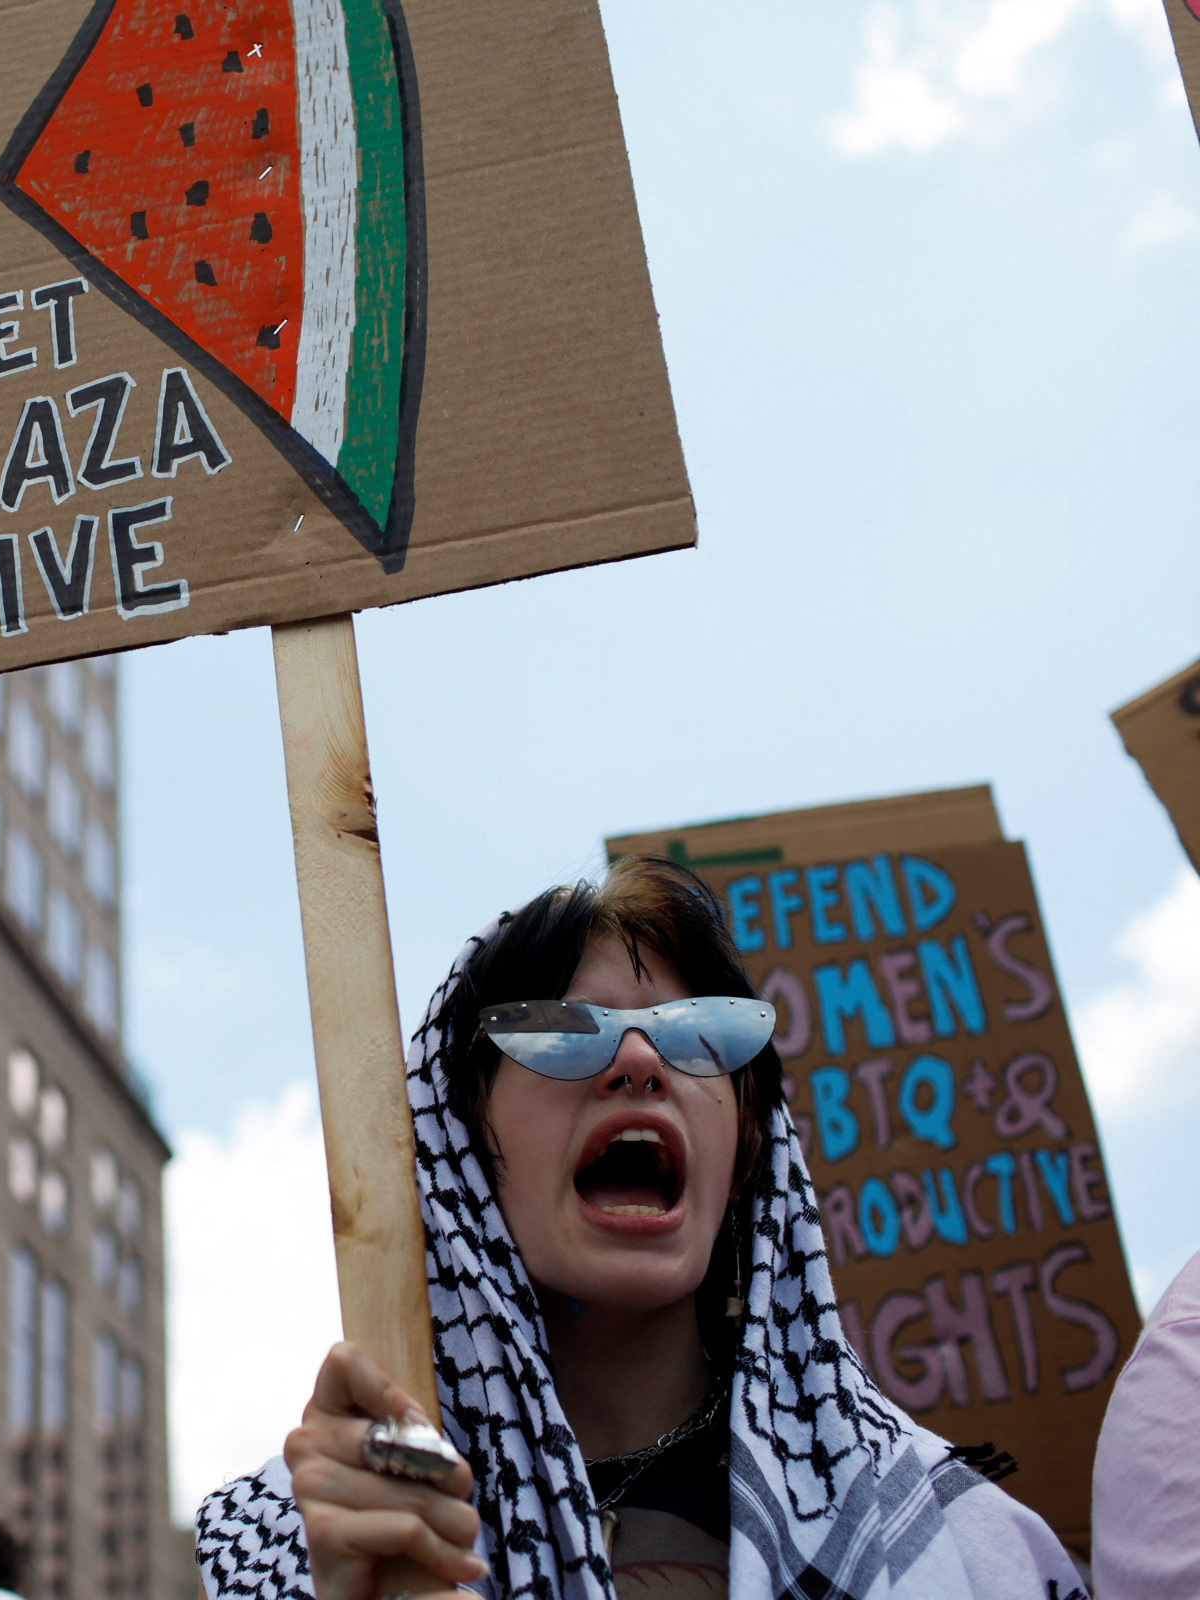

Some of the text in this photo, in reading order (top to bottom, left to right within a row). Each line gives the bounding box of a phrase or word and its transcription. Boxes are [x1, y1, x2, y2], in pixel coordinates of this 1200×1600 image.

[726, 853, 957, 953] EFEND
[761, 911, 1053, 1058] OMEN'S
[781, 1052, 1072, 1162] BTQ+ &
[822, 1143, 1111, 1266] RODUCTIVE
[838, 1240, 1120, 1412] IGHTS
